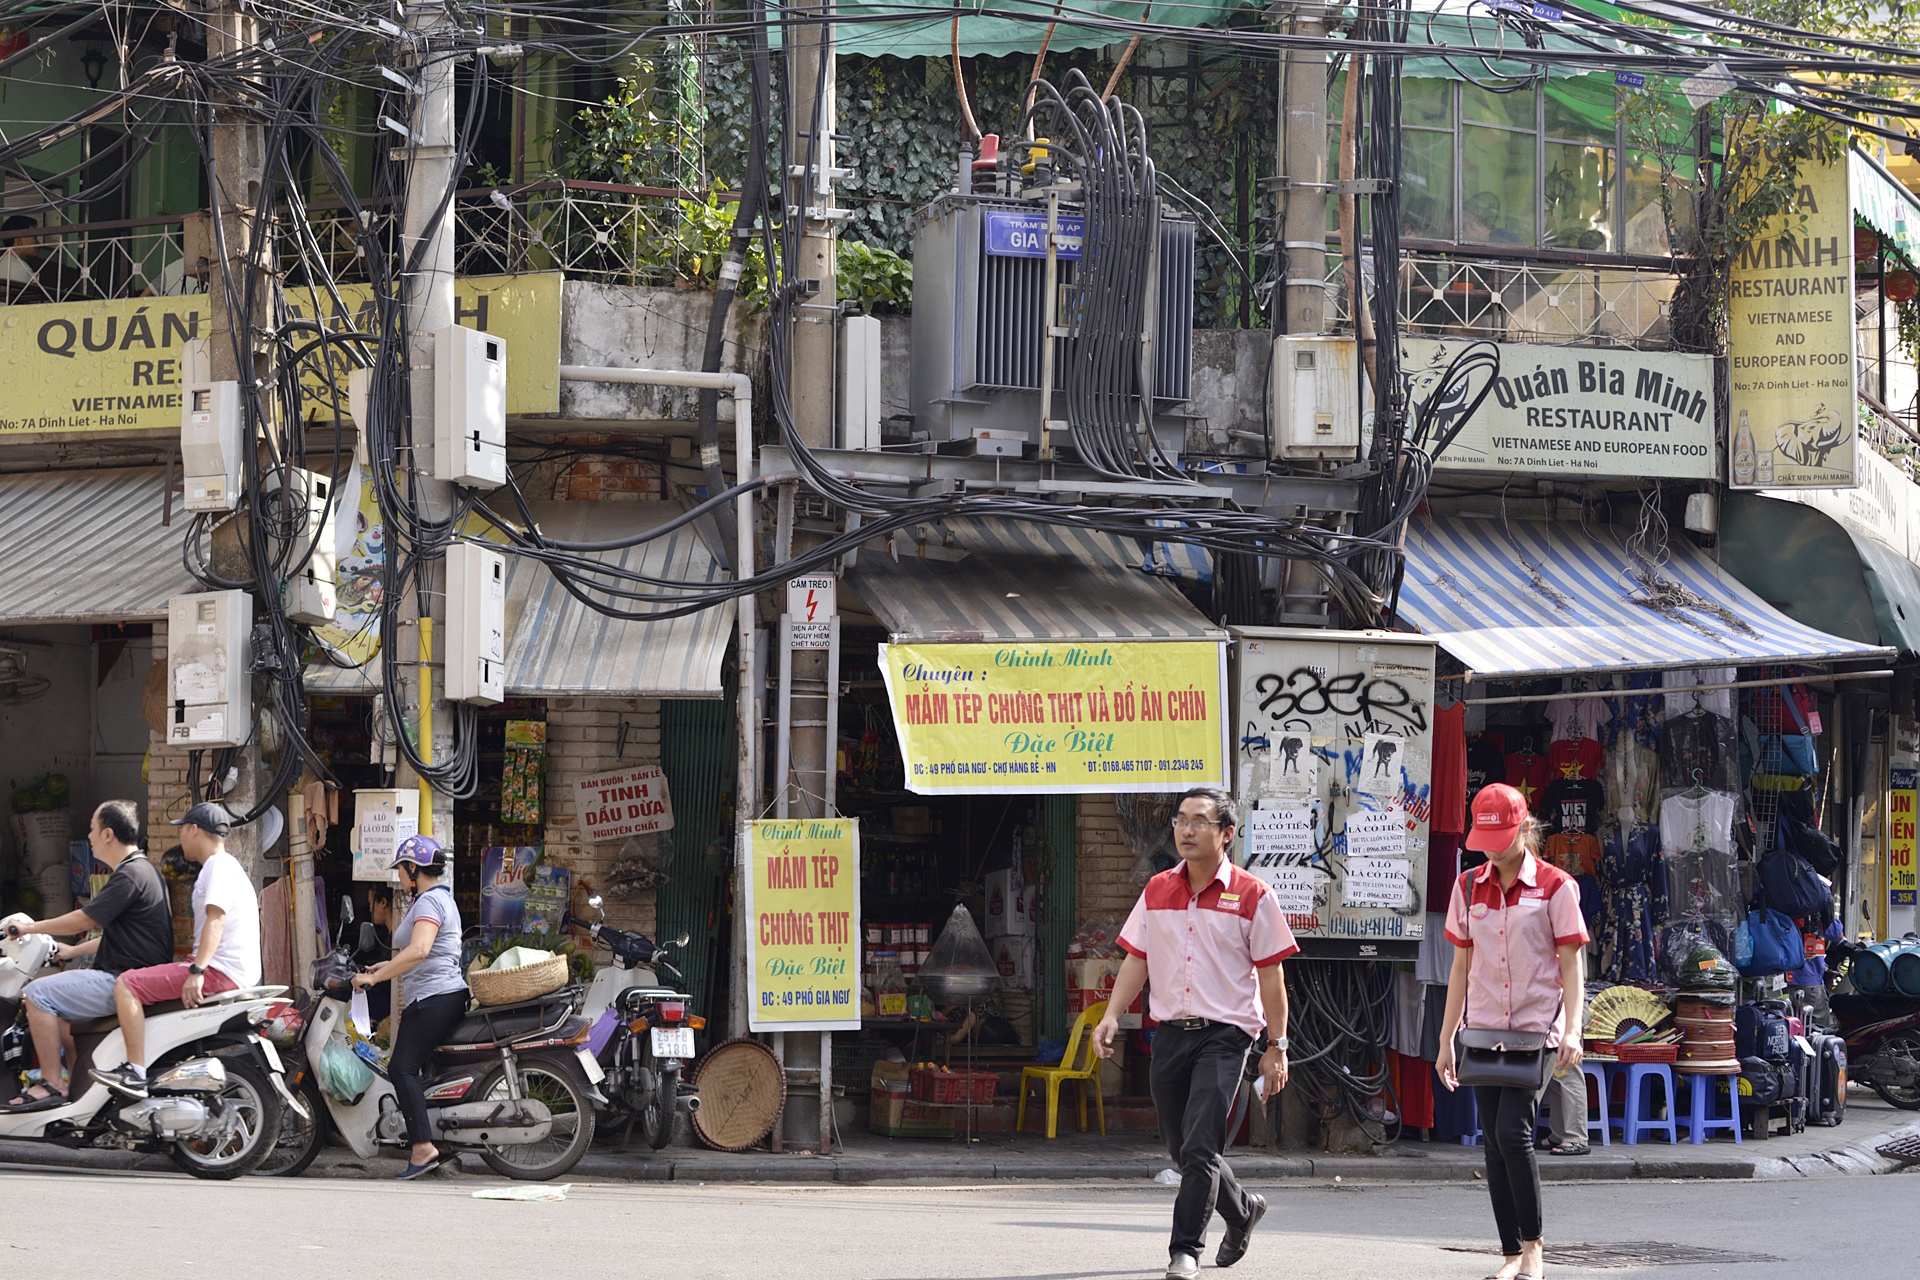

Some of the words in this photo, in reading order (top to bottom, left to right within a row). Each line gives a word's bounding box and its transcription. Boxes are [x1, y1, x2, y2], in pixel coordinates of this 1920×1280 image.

[1011, 232, 1039, 249] GIA
[1741, 237, 1838, 270] MINH
[1732, 277, 1848, 299] RESTAURANT
[1748, 310, 1833, 325] VIETNAMESE
[37, 306, 199, 358] QUÁN
[1776, 333, 1805, 346] AND
[1734, 355, 1806, 369] EUROPEAN
[1810, 353, 1849, 366] FOOD
[1493, 364, 1569, 410] Quán
[1578, 361, 1625, 396] Bia
[1635, 368, 1707, 424] Minh
[1753, 382, 1765, 391] 7A
[1767, 381, 1789, 390] Dinh
[1792, 381, 1809, 389] Liet
[1817, 380, 1830, 388] Ha
[1832, 379, 1848, 388] Noi
[0, 419, 19, 430] No:
[21, 418, 36, 429] 7A
[39, 416, 68, 428] Dinh
[70, 415, 90, 427] Liet
[99, 415, 115, 426] Ha
[117, 414, 137, 425] Noi
[1527, 407, 1673, 432] RESTAURANT
[1492, 437, 1571, 452] VIETNAMESE
[1574, 440, 1601, 453] AND
[1604, 441, 1670, 456] EUROPEAN
[1673, 444, 1708, 457] FOOD
[1498, 457, 1512, 465] No:
[1514, 457, 1525, 466] 7A
[1527, 457, 1547, 467] Dinh
[1548, 458, 1564, 467] Liet
[1571, 459, 1582, 468] Ha
[1584, 459, 1598, 468] Noi
[995, 649, 1054, 668] Chinh
[1058, 648, 1114, 667] Minh
[903, 663, 974, 685] Chuyên
[905, 683, 949, 725] MẮM
[953, 687, 983, 724] TÉP
[1048, 692, 1083, 730] THỊT
[1087, 685, 1110, 723] VÀ
[1114, 681, 1136, 723] ĐỒ
[1141, 684, 1163, 722] ĂN
[1167, 684, 1207, 721] CHÍN
[172, 726, 190, 738] FB
[1004, 731, 1057, 758] Đặc
[1064, 730, 1116, 758] Biệt
[930, 763, 939, 774] 49
[941, 759, 956, 775] PHỐ
[957, 762, 970, 774] GIA
[971, 762, 987, 774] NGƯ
[1009, 760, 1028, 773] HÀNG
[1046, 762, 1057, 773] HN
[1103, 761, 1134, 772] 0168.465
[1136, 760, 1152, 771] 7107
[1158, 760, 1189, 771] 091.2346
[1191, 759, 1204, 771] 245
[601, 775, 624, 787] BUÔN
[598, 784, 649, 804] TINH
[628, 800, 665, 819] DỪA
[1561, 802, 1587, 815] VIET
[1890, 792, 1910, 813] ÚN
[1279, 811, 1293, 820] LÔ
[1374, 813, 1387, 822] LÔ
[593, 824, 632, 838] NGUYÊN
[761, 824, 802, 840] Chinh
[805, 823, 842, 840] Minh
[1269, 821, 1283, 830] CÓ
[1364, 824, 1379, 833] CÓ
[1890, 844, 1910, 866] HỞ
[767, 845, 807, 889] MẮM
[812, 848, 839, 888] TÉP
[1377, 860, 1391, 868] LÔ
[1283, 871, 1297, 880] LÔ
[1367, 870, 1381, 878] CÓ
[1272, 881, 1287, 890] CÓ
[818, 912, 849, 952] THỊT
[765, 957, 804, 980] Đặc
[809, 956, 846, 980] Biệt
[782, 991, 793, 1006] 49
[795, 985, 813, 1006] PHỐ
[816, 990, 830, 1005] GIA
[832, 988, 850, 1005] NGƯ
[1774, 1025, 1785, 1036] THE
[658, 1043, 688, 1056] 5180
